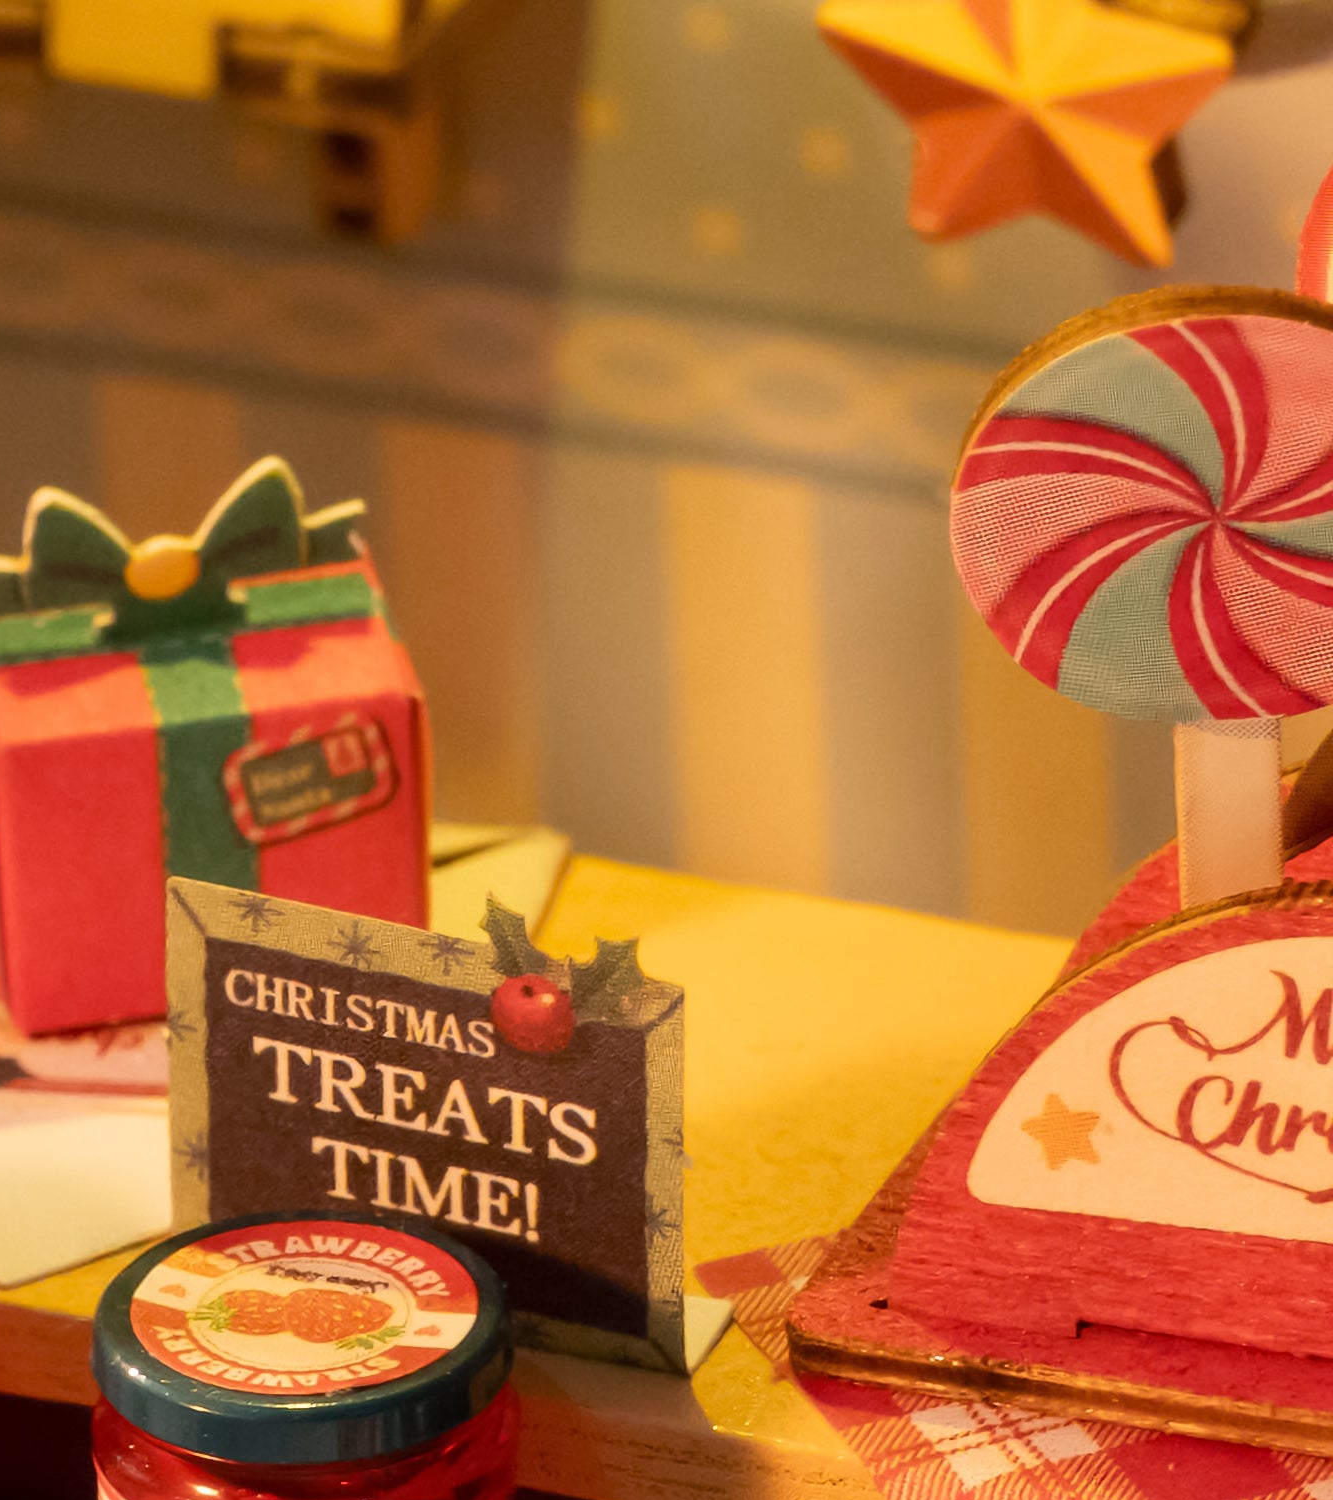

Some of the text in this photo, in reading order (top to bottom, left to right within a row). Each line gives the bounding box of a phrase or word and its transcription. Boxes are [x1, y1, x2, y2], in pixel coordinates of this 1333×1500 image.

[224, 969, 496, 1058] CHRISTMAS
[252, 1037, 597, 1166] TREATS
[313, 1137, 539, 1242] TIME!
[216, 1234, 451, 1297] STRAWBERRY
[152, 1325, 401, 1388] STRAWBERRY
